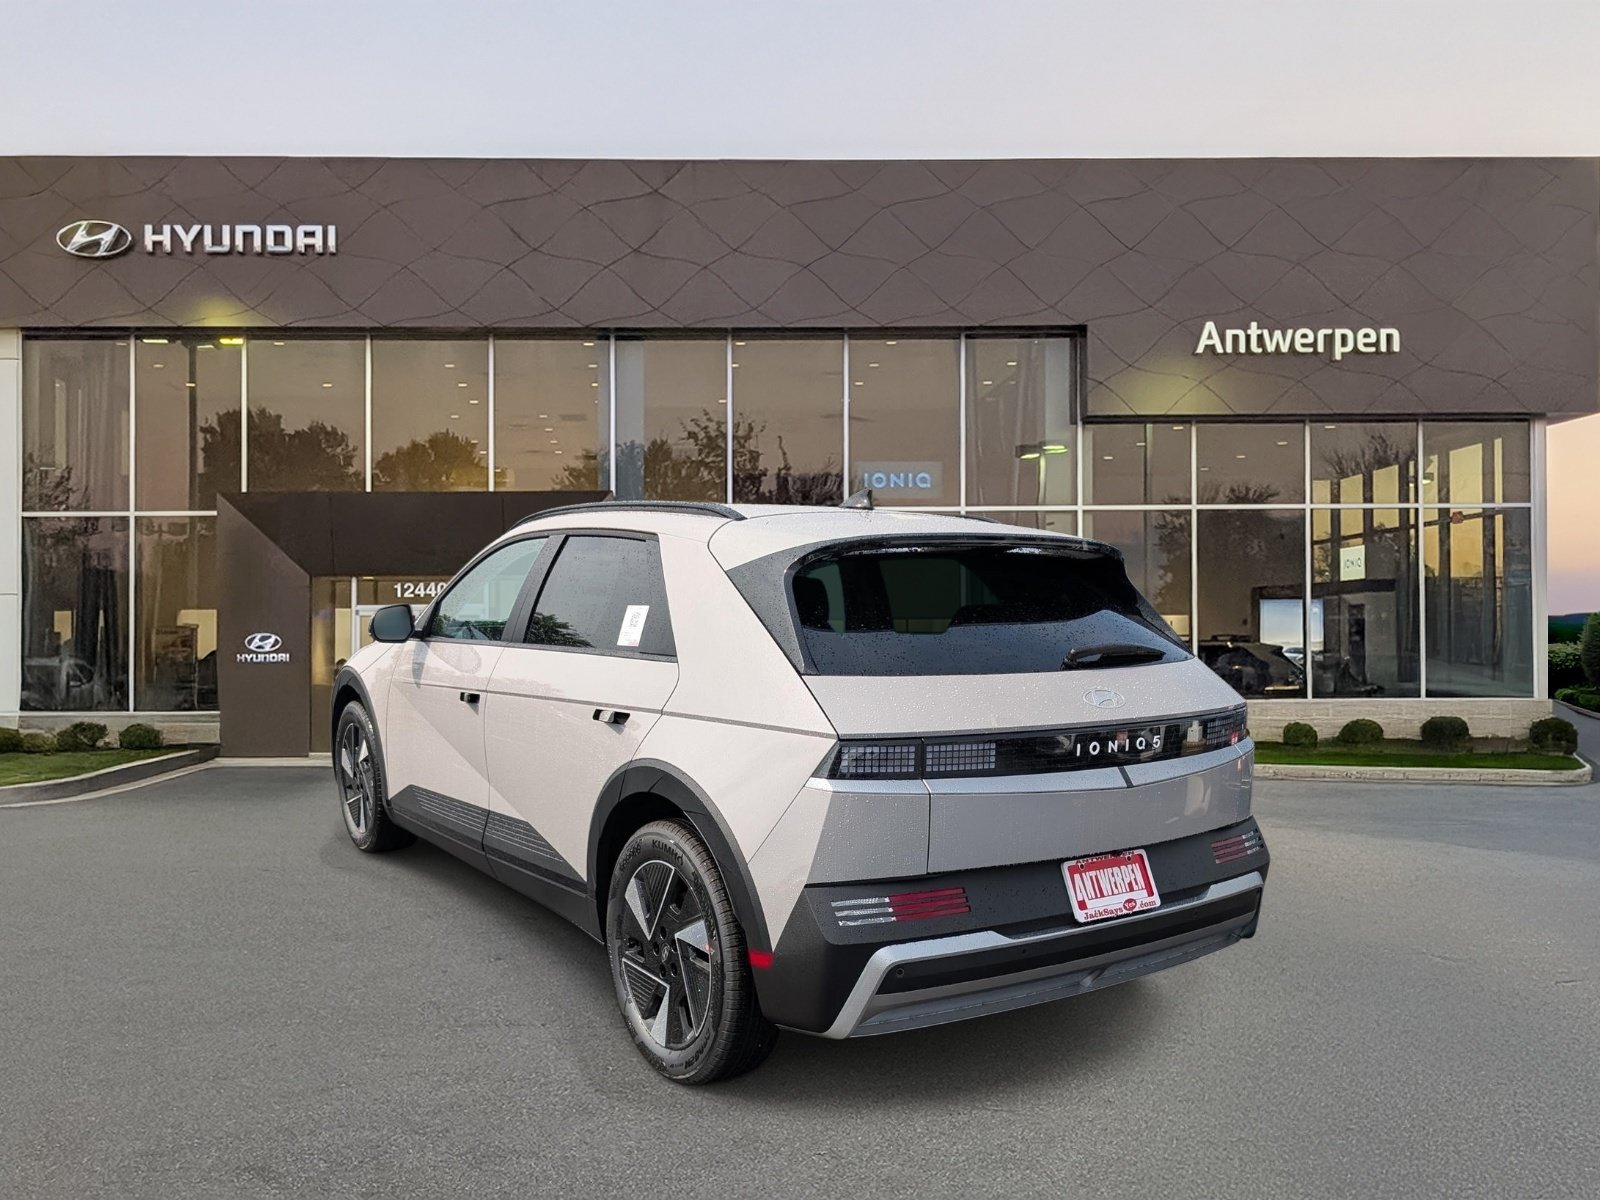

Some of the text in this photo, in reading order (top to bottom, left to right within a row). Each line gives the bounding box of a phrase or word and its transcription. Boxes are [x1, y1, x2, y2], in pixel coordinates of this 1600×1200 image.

[144, 224, 337, 254] HYUNDAI
[1195, 321, 1400, 361] Antwerpen
[863, 472, 932, 489] IONIQ
[236, 653, 290, 663] HYUNDAI
[1073, 863, 1146, 902] ANTWERPEN
[1083, 906, 1124, 920] JackSays
